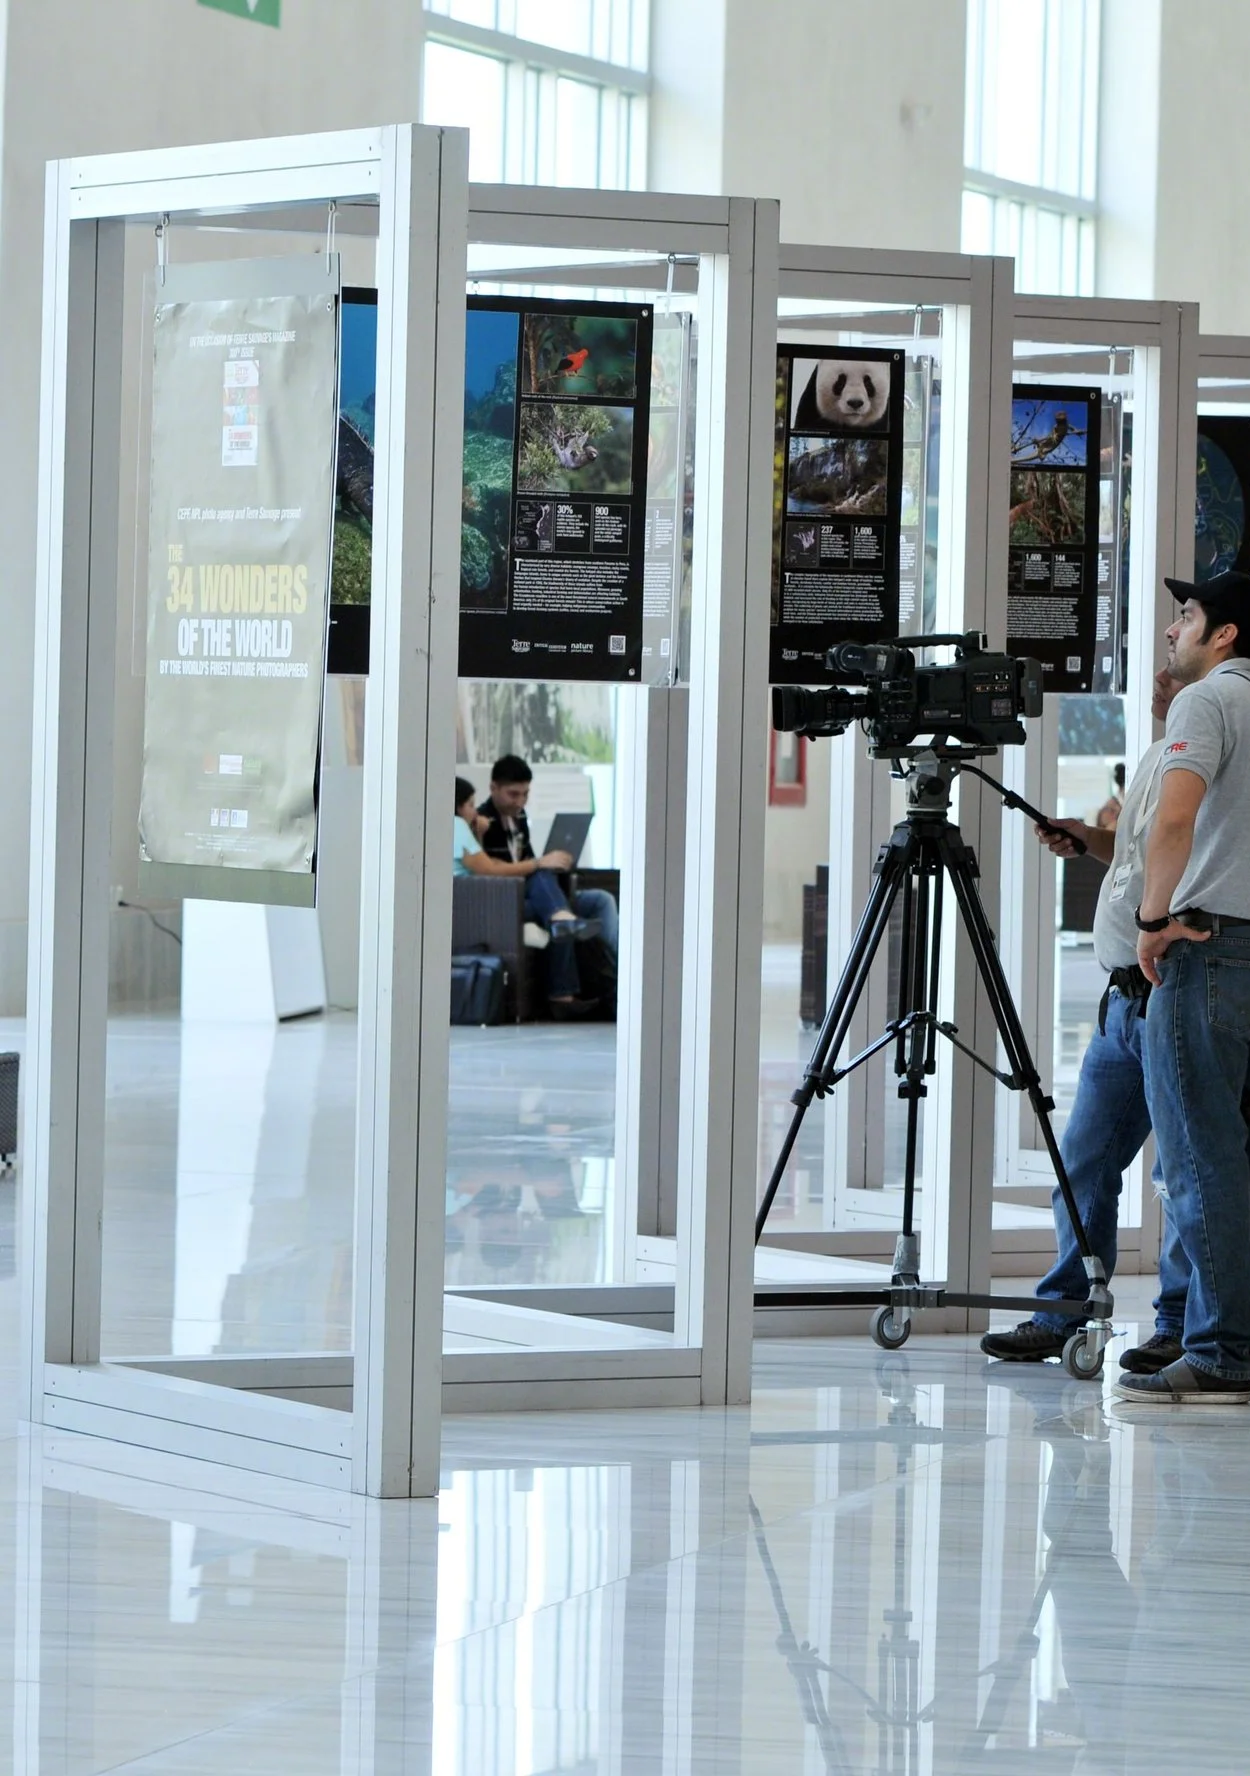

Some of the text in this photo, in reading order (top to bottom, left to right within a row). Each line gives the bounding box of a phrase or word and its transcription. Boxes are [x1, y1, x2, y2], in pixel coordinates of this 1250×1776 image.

[557, 504, 574, 515] 30%
[595, 506, 609, 516] 900
[821, 525, 834, 534] 237
[167, 544, 184, 563] THE
[166, 564, 308, 614] 34 WONDERS
[178, 618, 293, 658] OF THE WORLD
[159, 659, 309, 678] BY THE WORLD'S FINEST NATURE PHOTOGRAPHERS
